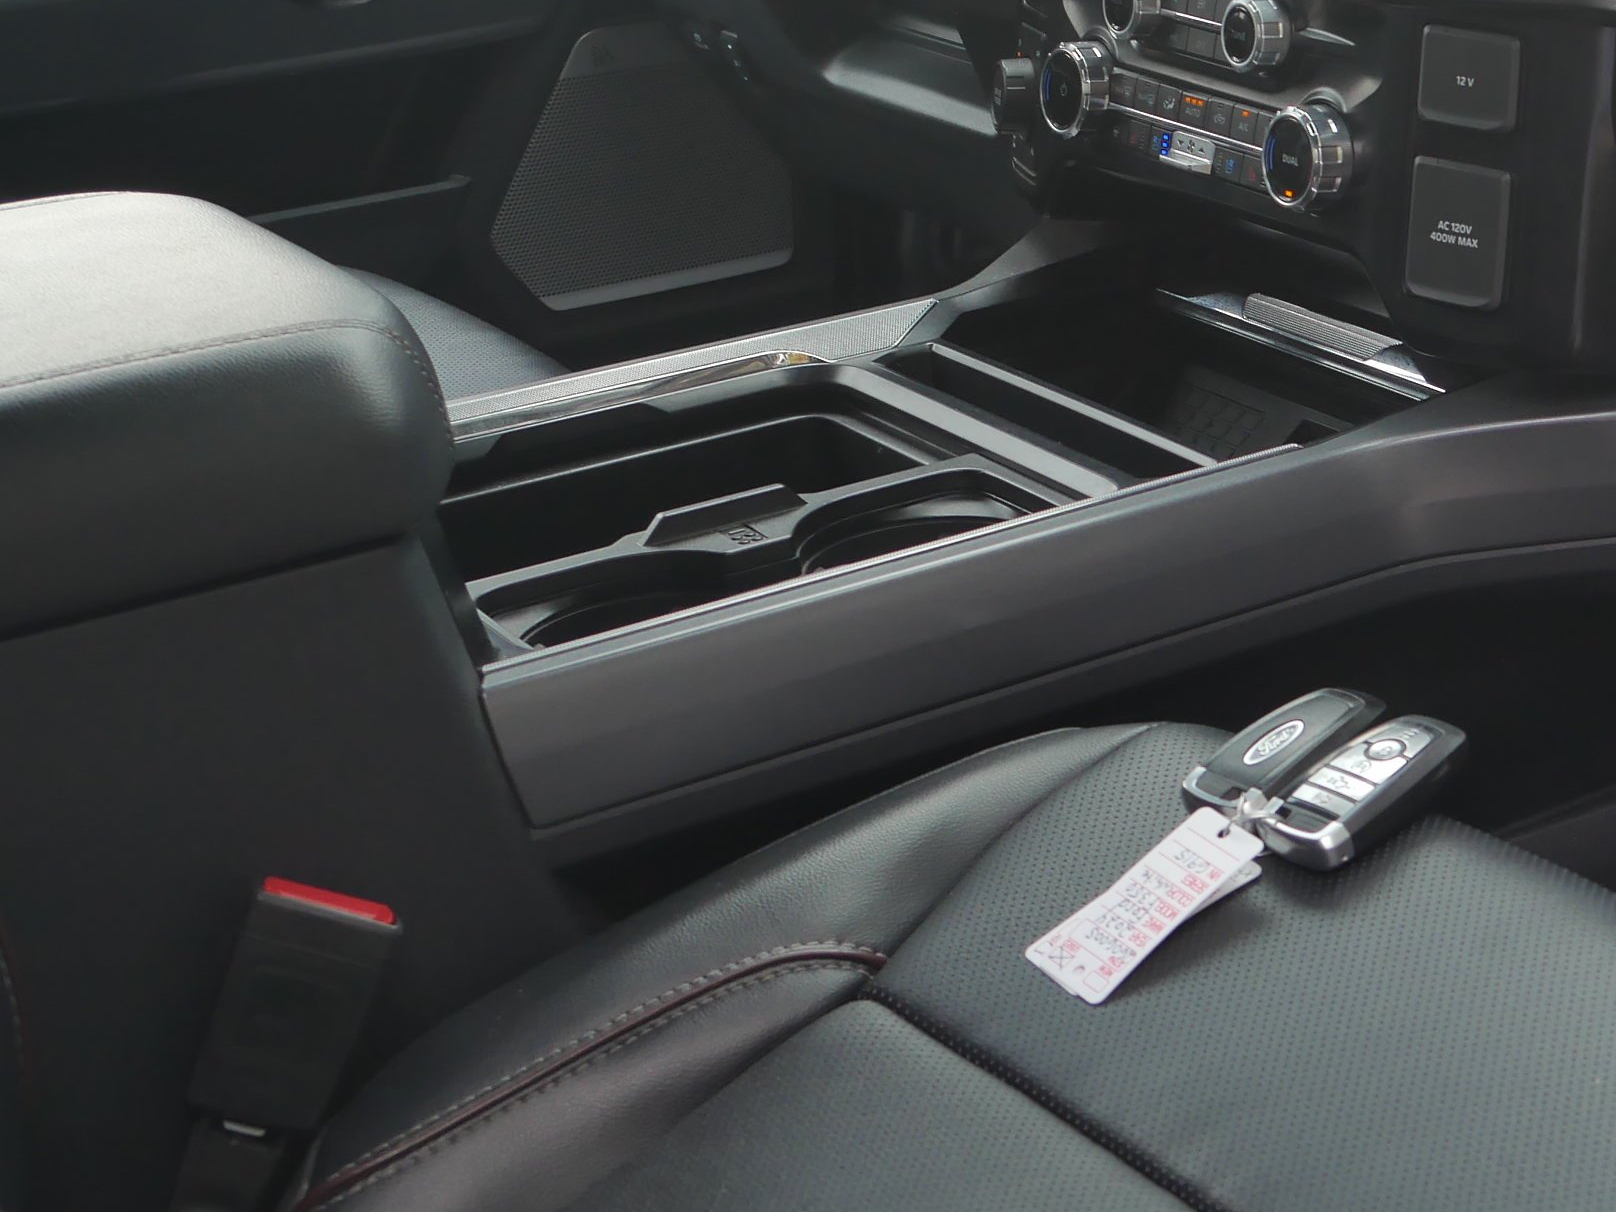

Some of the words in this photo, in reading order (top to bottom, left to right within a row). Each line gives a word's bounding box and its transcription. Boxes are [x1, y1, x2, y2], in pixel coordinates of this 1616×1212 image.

[1456, 75, 1466, 87] 12
[1281, 153, 1299, 167] DUAL
[1437, 220, 1450, 231] AC
[1450, 221, 1473, 235] 120V
[1430, 231, 1457, 244] 400W
[1457, 237, 1479, 249] MAX
